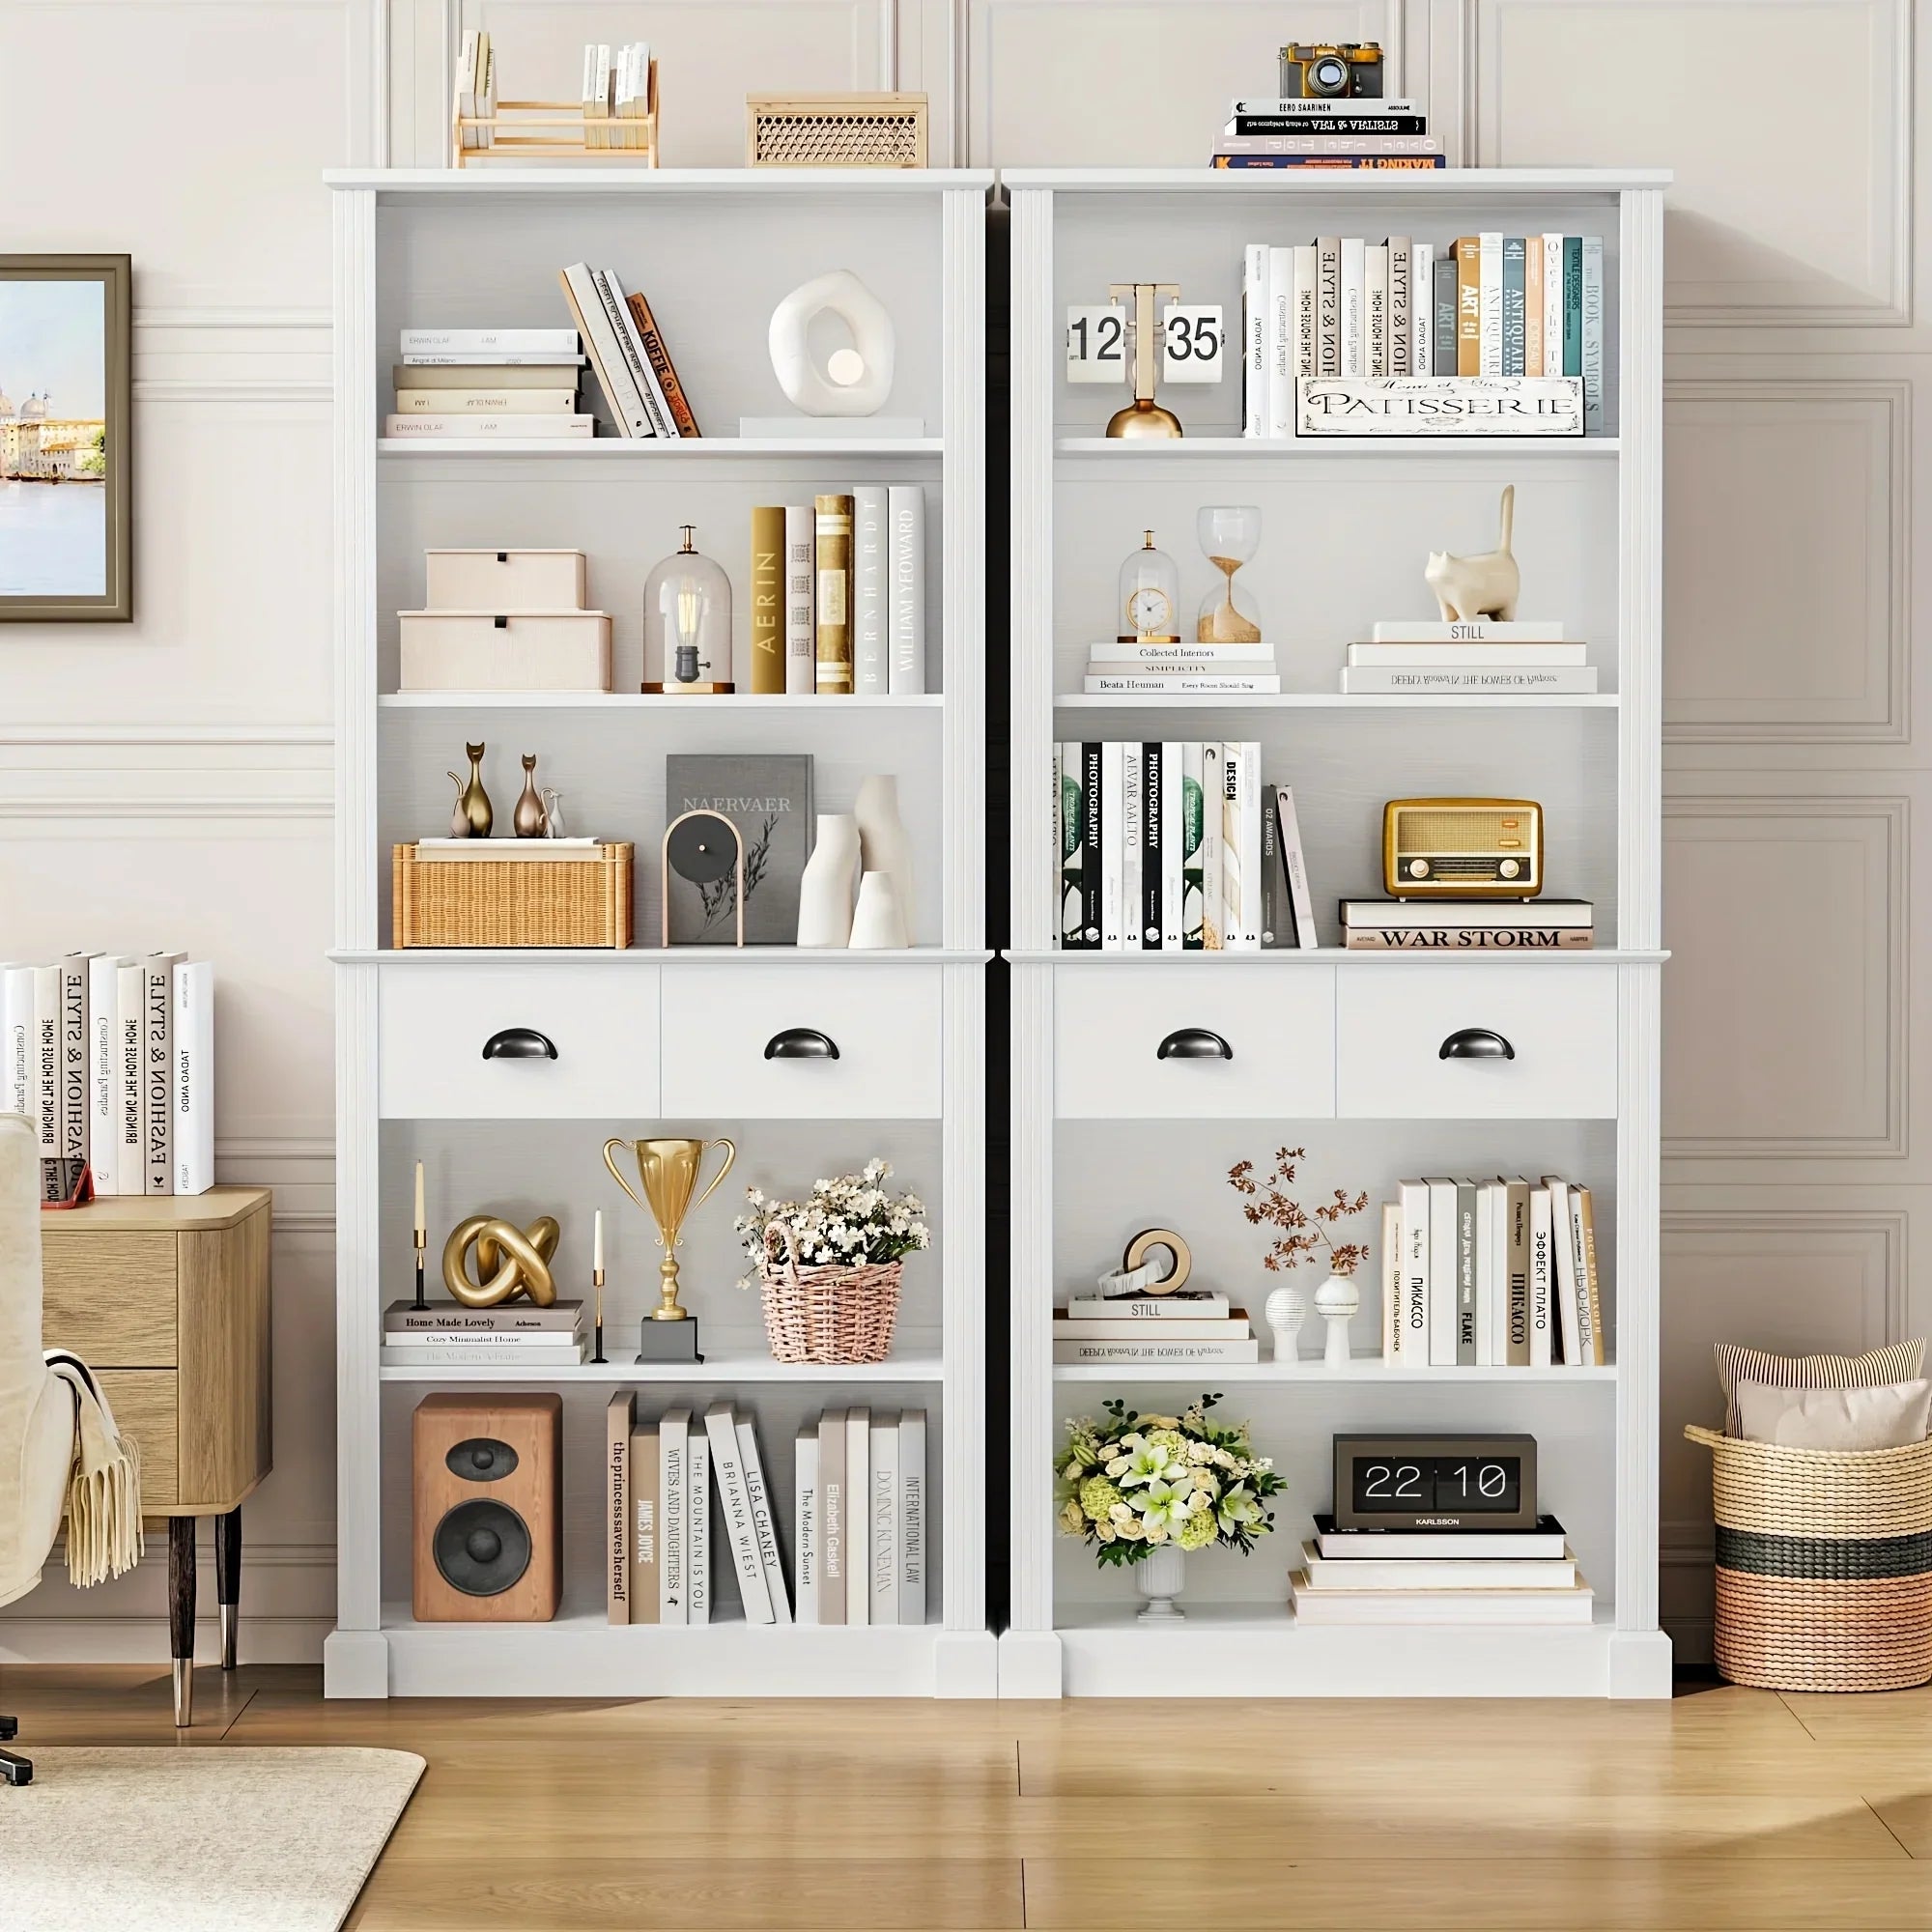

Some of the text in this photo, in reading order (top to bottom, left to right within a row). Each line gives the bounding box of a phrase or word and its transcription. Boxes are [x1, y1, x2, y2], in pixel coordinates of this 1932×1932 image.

[1279, 102, 1331, 112] EERO SAARINEN
[1358, 158, 1376, 168] IT
[1378, 158, 1435, 168] MAKING
[1382, 139, 1437, 150] Over
[1462, 284, 1478, 318] ART
[1572, 247, 1580, 310] TEXTILE DESIGNERS
[1438, 302, 1455, 330] ART
[1586, 286, 1600, 325] BOOK
[641, 329, 670, 377] KOFFIE
[1071, 317, 1122, 360] 12
[1167, 317, 1218, 361] 35
[1585, 340, 1600, 412] SYMBOLS
[1308, 392, 1577, 415] PATISSERIE
[756, 553, 777, 654] AERIN
[865, 499, 877, 683] BERNHARDT
[898, 509, 914, 672] WILLIAM YEOWARD
[1451, 626, 1485, 639] STILL
[1099, 680, 1164, 689] Beata Heuman
[684, 798, 792, 812] NAERVAER
[1090, 753, 1098, 849] PHOTOGRAPHY
[1126, 755, 1138, 846] ALVAR AALTO
[1150, 753, 1158, 849] PHOTOGRAPHY
[1227, 761, 1236, 801] DESIGN
[1379, 931, 1561, 947] WAR STORM
[45, 1167, 58, 1182] THE
[1411, 1277, 1424, 1329] ПИКАССО
[1536, 1232, 1546, 1329] ЭФФЕКТ ПЛАТО
[406, 1319, 495, 1329] Home Made Lovely
[1131, 1304, 1161, 1316] STILL
[1463, 1312, 1472, 1345] FLAKE
[1511, 1273, 1524, 1345] ПИКАССО
[876, 1470, 893, 1525] DOMINIC
[1366, 1465, 1422, 1497] 22
[1454, 1464, 1507, 1497] 10
[611, 1441, 626, 1601] the princess saves herself
[638, 1499, 653, 1564] JAMES JOYCE
[668, 1449, 680, 1590] WIVES AND DAUGHTERS
[694, 1456, 703, 1609] THE MOUNTAIN IS YOU
[723, 1462, 757, 1578] BRIANNA WIEST
[747, 1470, 777, 1567] LISA CHANEY
[802, 1489, 813, 1586] The Modern Sunset
[827, 1484, 840, 1578] Elizabeth Gaskell
[906, 1476, 920, 1584] INTERNATIONAL LAW
